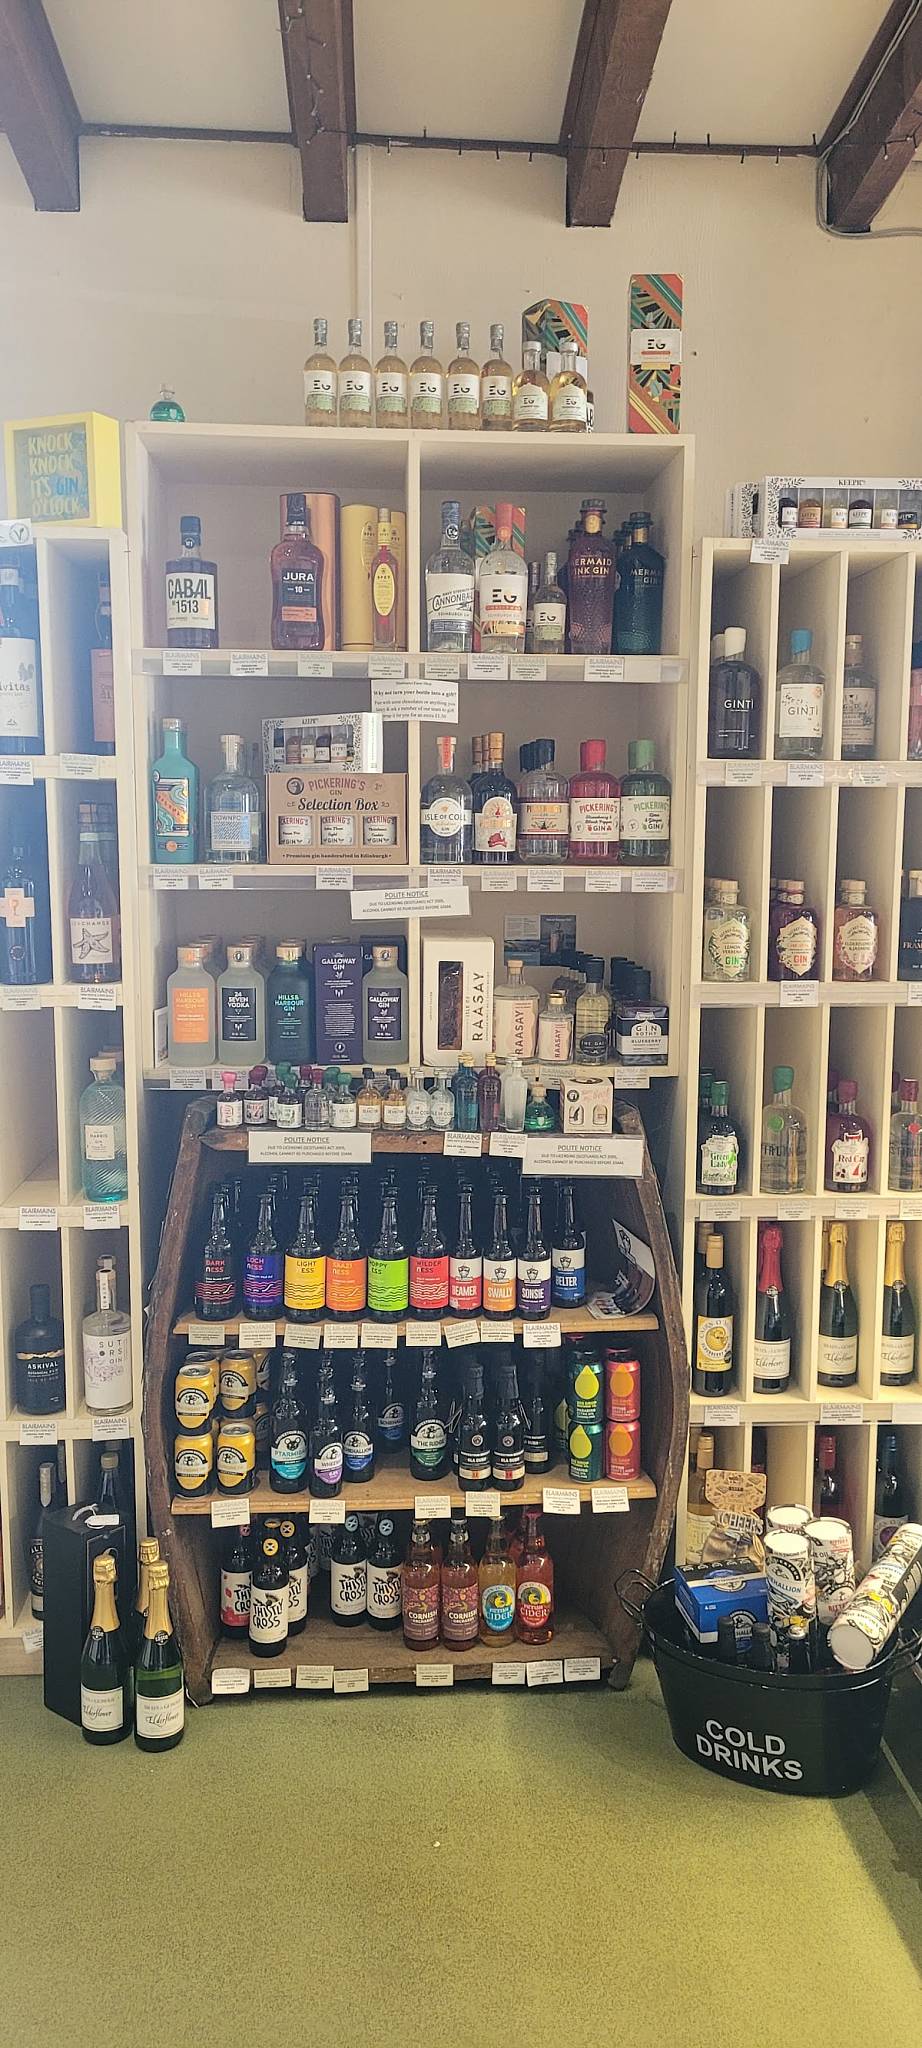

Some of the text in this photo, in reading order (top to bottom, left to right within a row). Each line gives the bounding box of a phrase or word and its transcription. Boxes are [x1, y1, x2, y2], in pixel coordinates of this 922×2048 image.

[648, 339, 666, 349] EG
[314, 380, 330, 392] EG
[346, 380, 364, 392] EG
[382, 382, 399, 393] EG
[420, 382, 437, 394] EG
[453, 383, 470, 394] EG
[488, 385, 506, 396] EG
[28, 432, 74, 456] KNOCK
[28, 453, 74, 476] KNOCK
[31, 475, 78, 498] IT'S GIN
[32, 496, 80, 516] O'CLOCK
[573, 556, 612, 567] ERMAID
[574, 566, 610, 576] INK GIN
[282, 572, 315, 582] JURA
[168, 578, 212, 600] CABAL
[294, 586, 304, 594] 10
[492, 588, 517, 604] EG
[176, 600, 199, 614] 1513
[540, 612, 556, 622] EG
[724, 700, 754, 708] GINTI
[788, 706, 818, 716] GINTI
[308, 778, 366, 792] PICKERING'S
[298, 798, 379, 811] Selection Box
[580, 803, 618, 814] PICKERING'S
[634, 801, 670, 812] PICKERING'S
[280, 817, 308, 826] CKERING'S
[323, 816, 350, 824] CKERING'S
[367, 816, 395, 824] CKERING'S
[449, 813, 467, 821] COLL
[406, 890, 428, 898] NOTICE
[725, 956, 740, 964] GIN
[793, 955, 808, 964] GIN
[80, 986, 114, 994] BLAIRMAINS
[472, 972, 484, 1041] RAASAY
[515, 1010, 524, 1055] RAASAY
[710, 1153, 728, 1161] Green
[838, 1154, 851, 1163] Red
[710, 1160, 727, 1169] Lady
[555, 1276, 577, 1287] BELTER
[452, 1285, 477, 1296] BEAMER
[488, 1286, 512, 1297] SWALLY
[522, 1287, 544, 1299] SONSIE
[721, 1511, 764, 1535] CHEERS
[339, 1573, 367, 1590] THISTL
[373, 1576, 400, 1593] THISTL
[770, 1578, 802, 1593] HALLION
[234, 1588, 250, 1600] THI
[340, 1588, 365, 1602] CROSS
[374, 1591, 400, 1606] CROSS
[235, 1600, 250, 1613] CRO
[253, 1599, 284, 1618] THISTLY
[408, 1610, 438, 1620] CORNISH
[449, 1610, 477, 1619] CORNISH
[486, 1611, 512, 1620] CIDER
[520, 1608, 547, 1617] CIDER
[253, 1614, 280, 1629] CROSS
[145, 1712, 179, 1728] Elderflower
[705, 1719, 786, 1756] COLD
[695, 1734, 803, 1780] DRINKS
